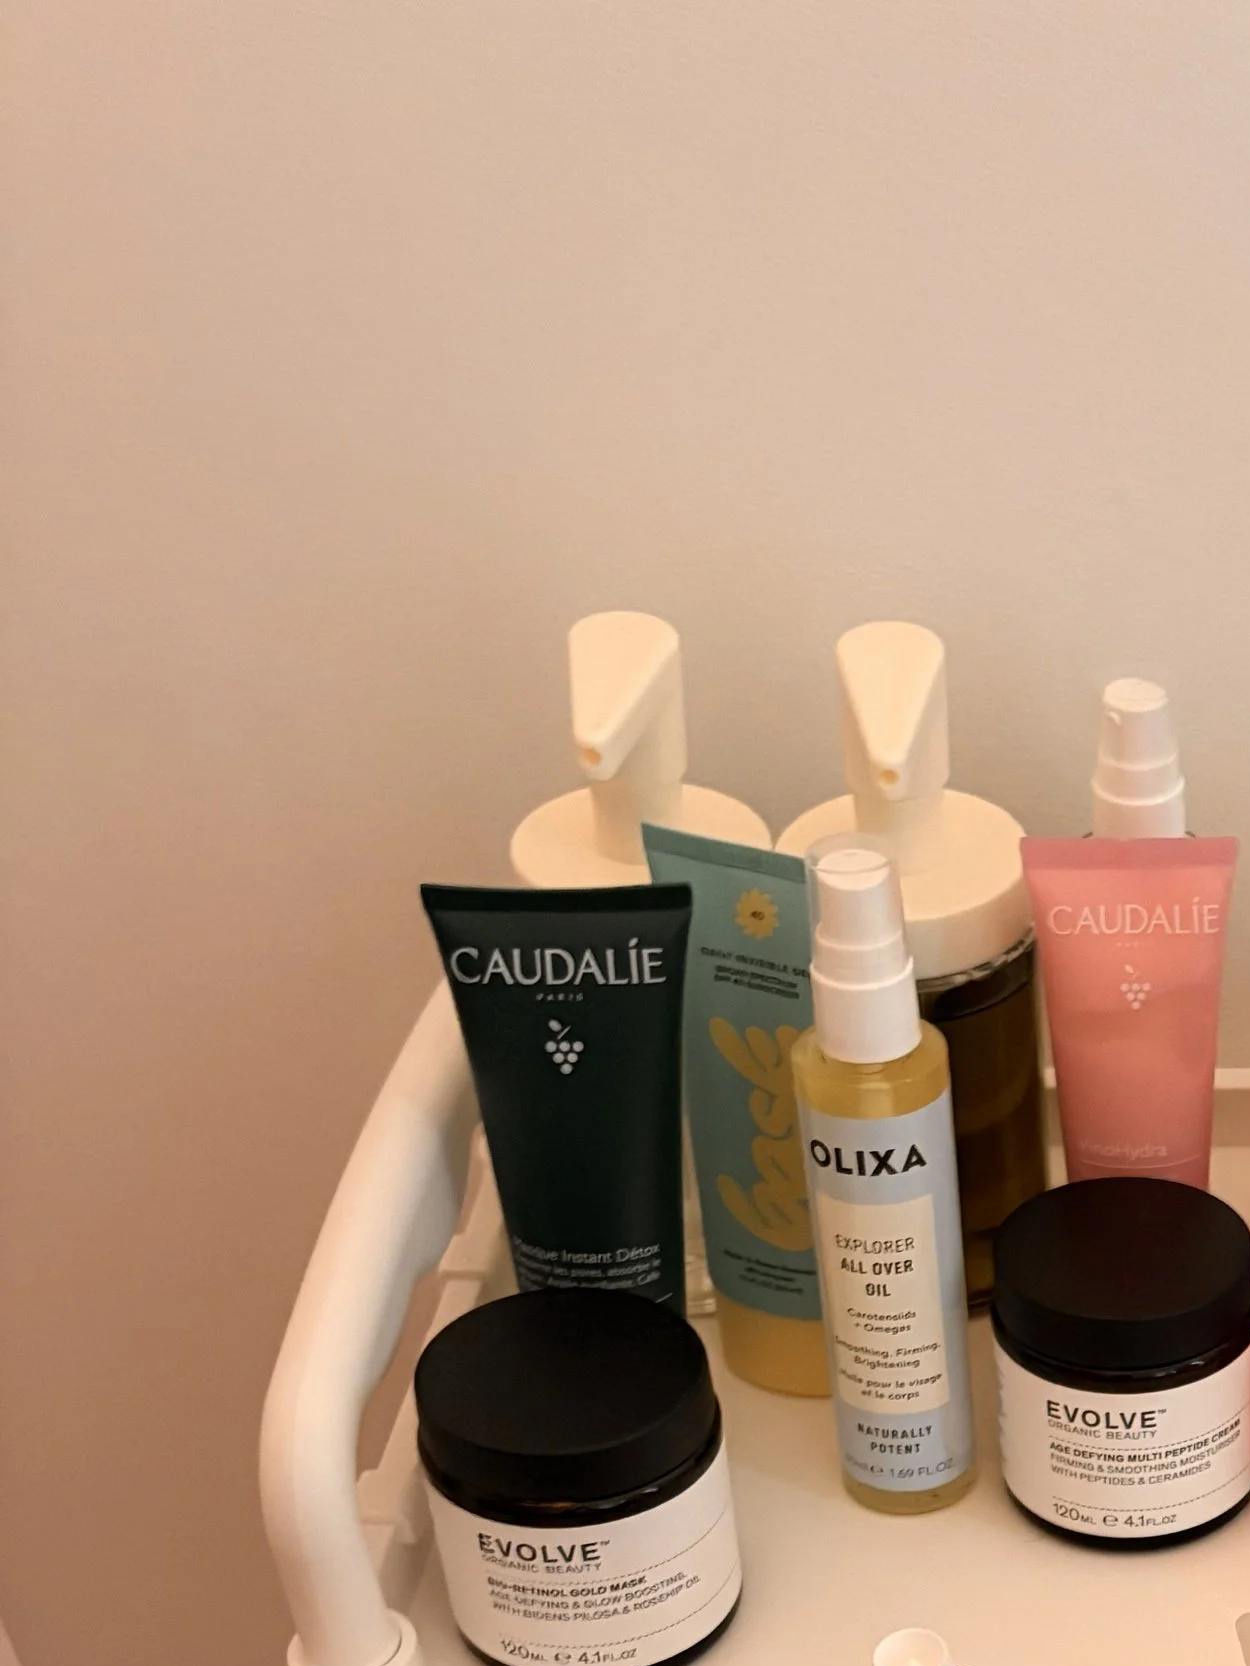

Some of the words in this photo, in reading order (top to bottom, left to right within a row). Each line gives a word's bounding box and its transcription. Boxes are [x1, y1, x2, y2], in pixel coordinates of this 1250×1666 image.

[1050, 896, 1221, 934] CAUDALÍE
[450, 937, 667, 985] CAUDALÍE
[810, 1139, 927, 1177] OLIXA
[835, 1233, 915, 1255] EXPLORER
[841, 1257, 867, 1275] ALL
[872, 1259, 914, 1276] OVER
[865, 1283, 891, 1298] OIL
[864, 1323, 912, 1335] Omegas
[854, 1356, 921, 1370] Brightening
[866, 1379, 892, 1389] pour
[895, 1379, 906, 1389] le
[908, 1373, 943, 1388] visage
[888, 1390, 920, 1401] corps
[857, 1422, 933, 1440] NATURALLY
[1047, 1418, 1101, 1439] ORGANIC
[1106, 1429, 1158, 1441] BEAUTY
[1050, 1441, 1071, 1456] AGE
[1073, 1448, 1125, 1463] DEFYING
[1127, 1451, 1163, 1463] MULTI
[1164, 1439, 1209, 1461] PEPTIDE
[1210, 1418, 1241, 1444] CREAM
[870, 1441, 921, 1455] POTENT
[1050, 1452, 1095, 1473] FIRMING
[1096, 1463, 1105, 1474] &
[1107, 1459, 1177, 1475] SMOOTHING
[1051, 1463, 1078, 1479] WITH
[1080, 1471, 1136, 1486] PEPTIDES
[1137, 1476, 1146, 1486] &
[1148, 1460, 1212, 1486] CERAMIDES
[1052, 1502, 1098, 1526] 120ML
[480, 1553, 540, 1574] ORGANIC
[545, 1562, 602, 1575] BEAUTY
[569, 1585, 607, 1598] GOLD
[609, 1575, 647, 1593] MASK
[583, 1594, 622, 1610] GLOW
